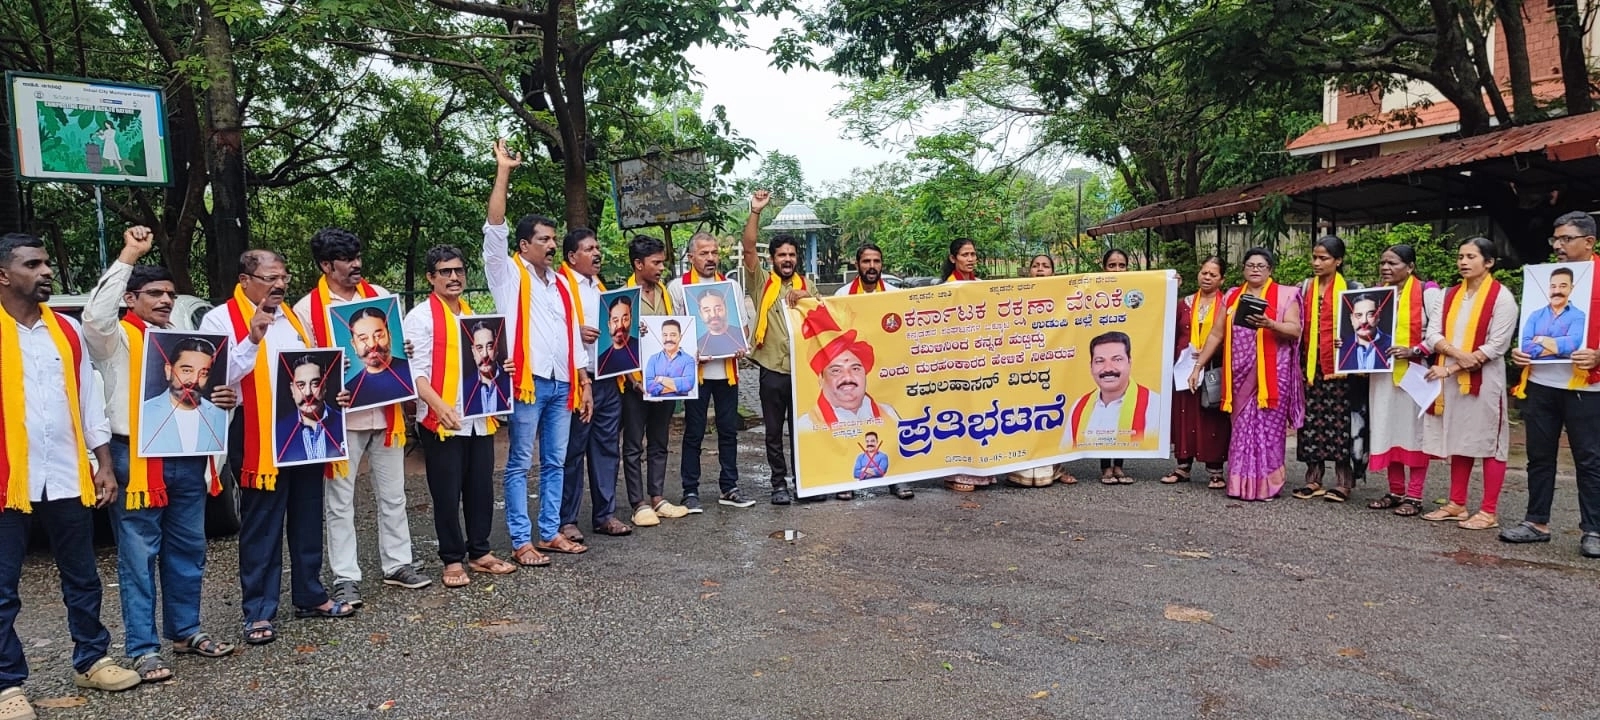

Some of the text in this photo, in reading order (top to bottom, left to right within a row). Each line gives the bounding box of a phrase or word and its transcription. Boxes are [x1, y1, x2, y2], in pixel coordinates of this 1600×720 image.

[904, 289, 1122, 327] ಕರ್ನಾಟಕ ರಕ್ಷಣಾ ವೇದಿಕೆ
[1032, 312, 1127, 330] ಉಡುಪಿ ಜಿಲ್ಲೆ ಘಟಕ
[911, 331, 1045, 355] ತಮಿಳಿನಿಂದ ಕನ್ನಡ ಹುಟ್ಟಿದ್ದು
[880, 347, 1075, 378] ಎಂದು ದುರಹಂಕಾರದ ಹೇಳಿಕೆ ನೀಡಿರುವ
[906, 372, 999, 397] ಕಮಲಹಾಸನ್
[898, 394, 1067, 458] ಪ್ರತಿಭಟನೆ
